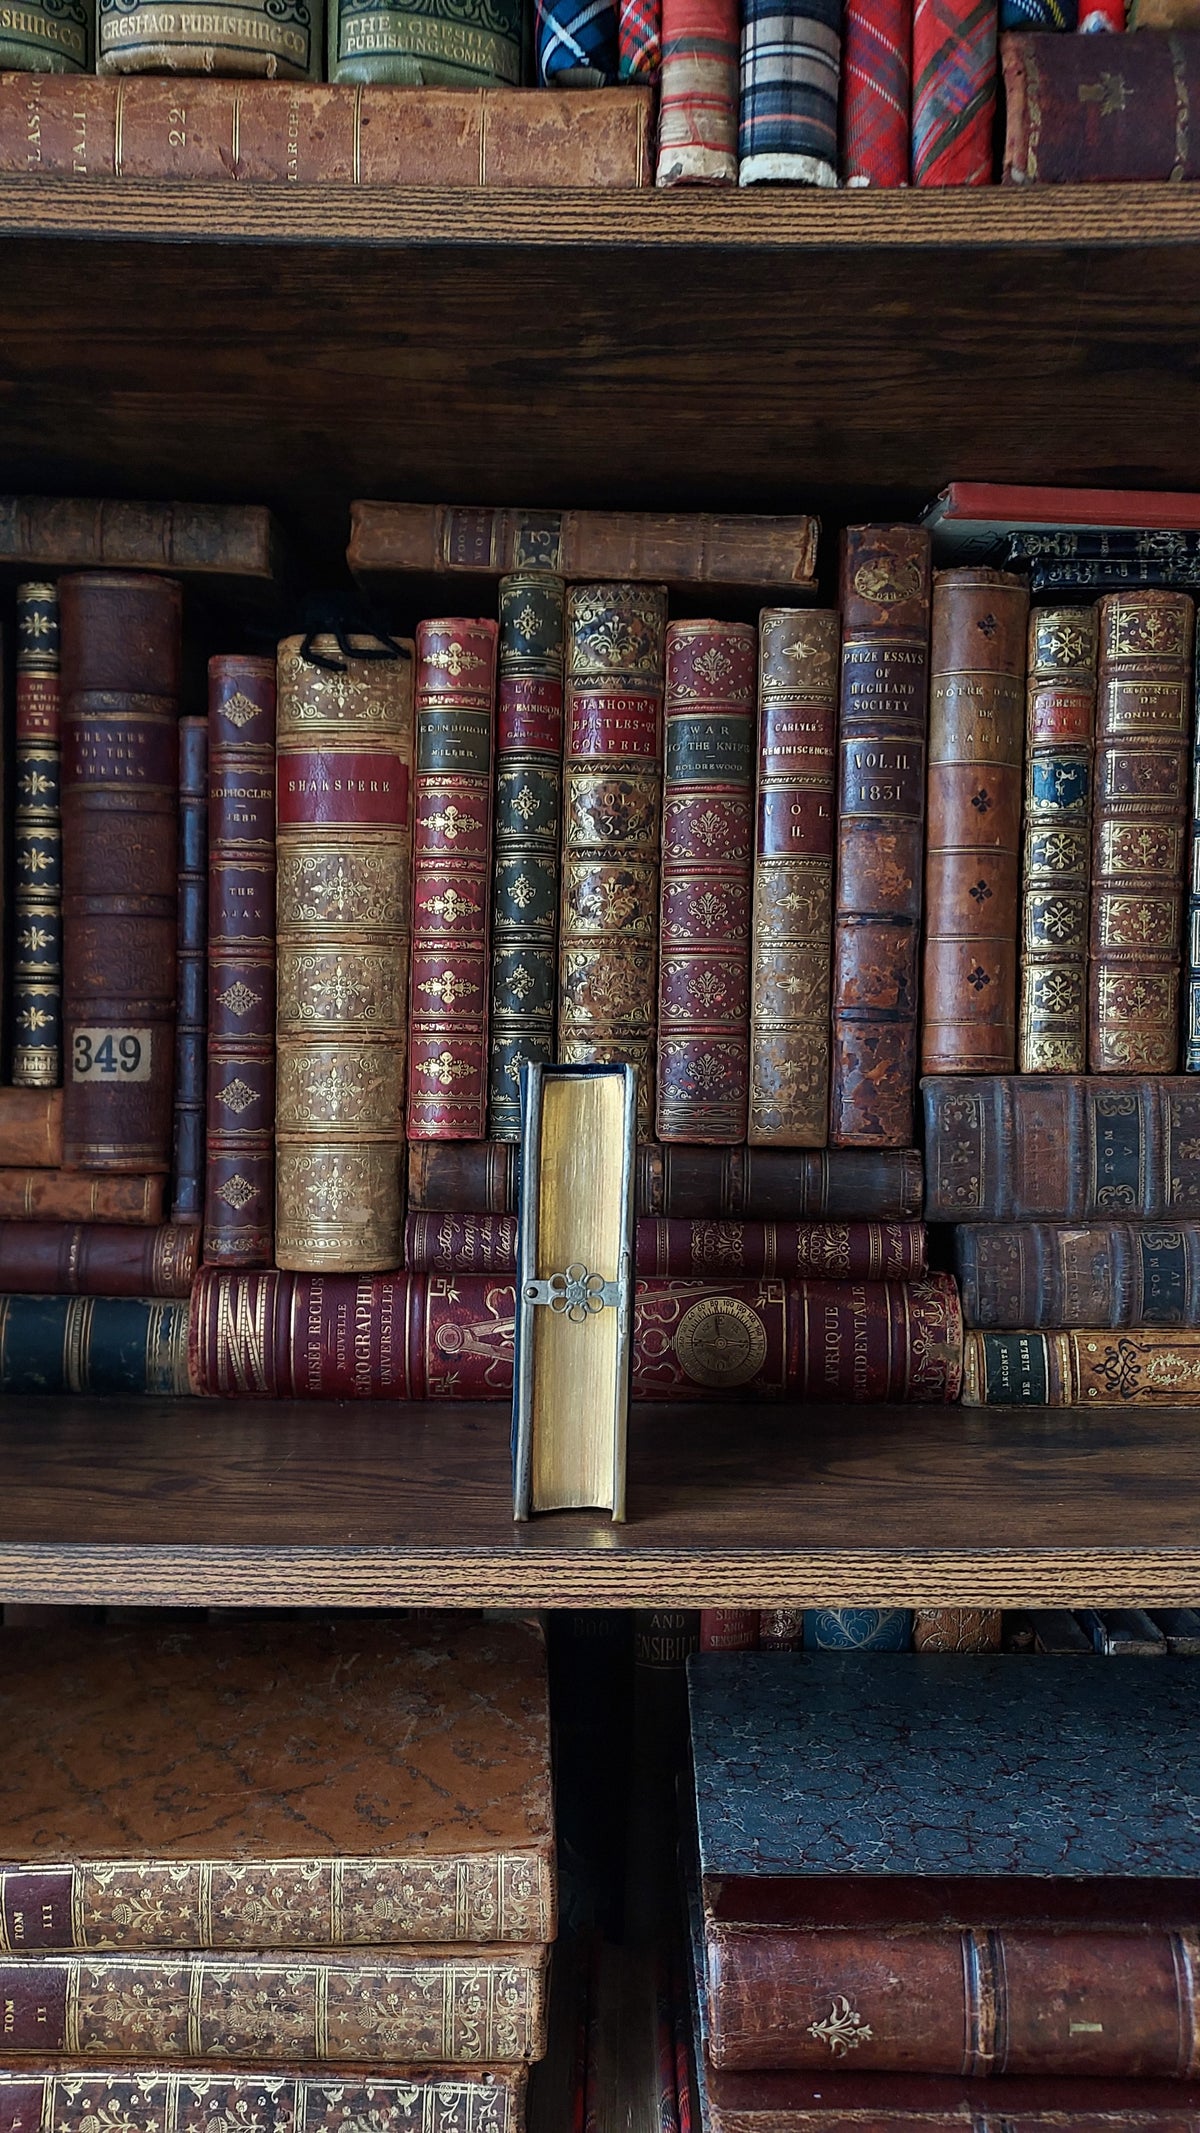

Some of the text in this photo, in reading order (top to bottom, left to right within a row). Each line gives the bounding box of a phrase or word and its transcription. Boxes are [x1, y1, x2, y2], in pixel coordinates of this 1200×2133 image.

[103, 14, 175, 40] GRESHAM
[180, 14, 282, 44] PUBLISHING
[346, 16, 391, 35] THE
[169, 108, 186, 147] 22
[844, 652, 924, 664] PRIZE ESSAYS
[875, 667, 890, 678] OF
[515, 684, 545, 696] LIFE
[851, 683, 915, 695] HIGHLAND
[936, 686, 984, 698] NOTRE
[853, 700, 910, 711] SOCIETY
[979, 709, 993, 719] DE
[690, 725, 730, 736] WAR
[775, 720, 824, 732] CARLYLE'S
[74, 732, 146, 744] THEATRE
[572, 738, 651, 752] GOSPELS
[687, 741, 710, 750] THE
[81, 748, 135, 758] OF THE
[675, 763, 743, 772] BOLDREWOOD
[854, 753, 893, 769] VOL.
[76, 765, 146, 777] GREEKS
[288, 780, 391, 793] SHAKSPERE
[859, 785, 903, 800] 1831
[211, 788, 272, 800] SOPHOCLES
[229, 887, 254, 896] THE
[221, 909, 262, 919] AJAX
[74, 1034, 142, 1073] 349
[1104, 1130, 1115, 1175] TOM
[308, 1277, 326, 1335] RECLUS
[337, 1303, 347, 1370] NOUVELLE
[380, 1284, 394, 1386] UNIVERSELLE
[824, 1305, 843, 1387] AFRIQUE
[1001, 1347, 1010, 1388] LECONTE
[1019, 1338, 1032, 1396] DE LISLE
[650, 1613, 686, 1629] AND
[42, 1904, 53, 1928] III
[14, 1911, 25, 1941] TOM
[4, 1999, 15, 2033] TOM
[37, 2006, 47, 2022] II
